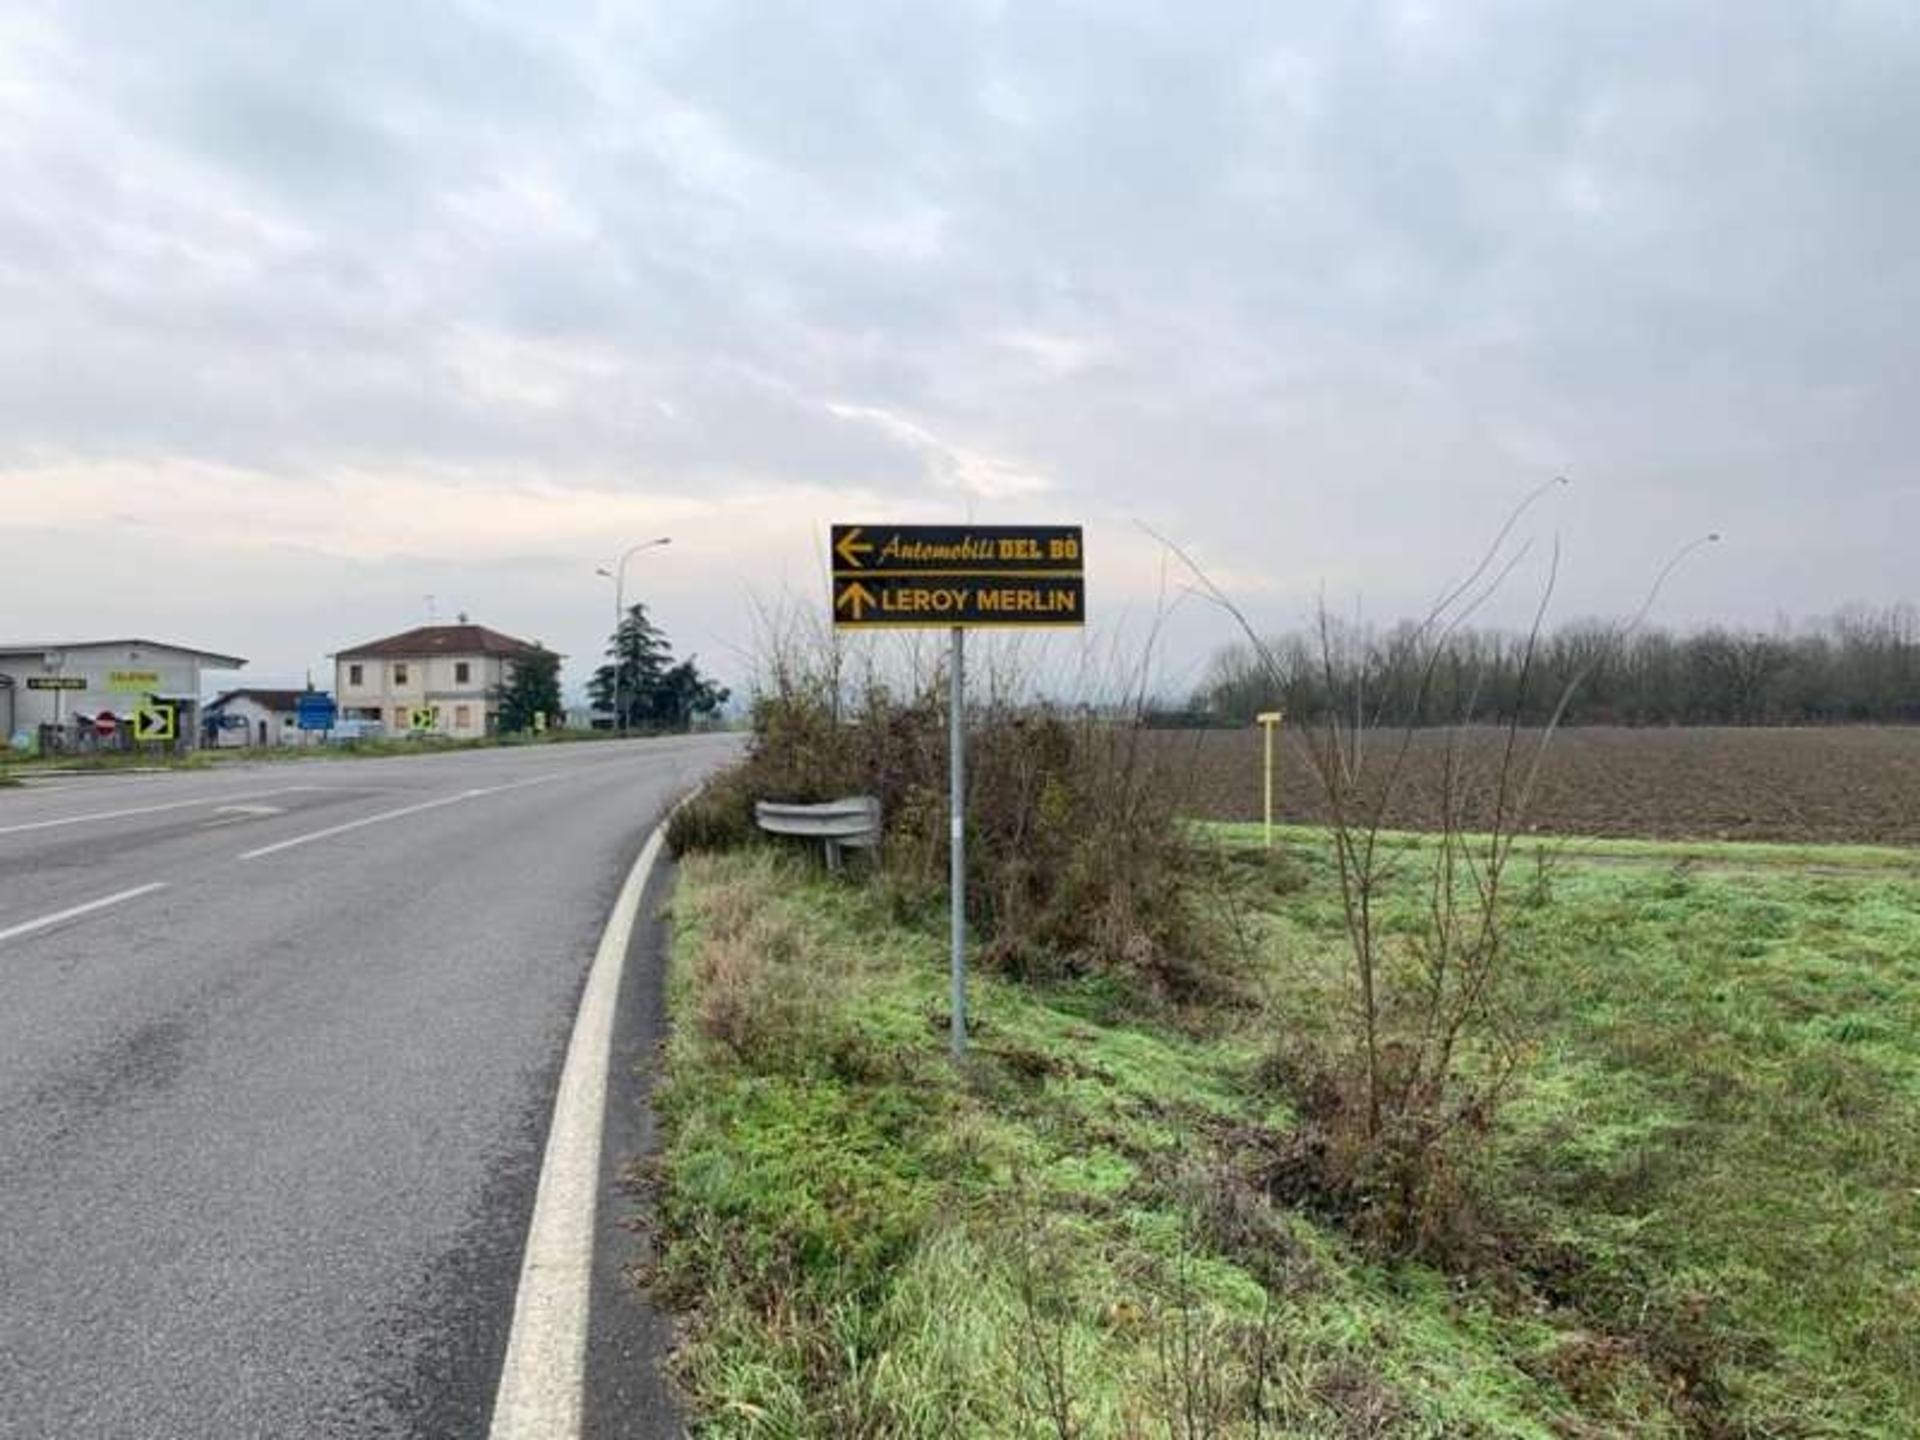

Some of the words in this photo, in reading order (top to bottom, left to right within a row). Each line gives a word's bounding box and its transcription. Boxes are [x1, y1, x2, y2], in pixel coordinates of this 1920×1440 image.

[878, 534, 994, 563] Automobili
[999, 539, 1043, 559] DEL
[882, 589, 968, 611] LEROY
[977, 589, 1076, 611] MERLIN
